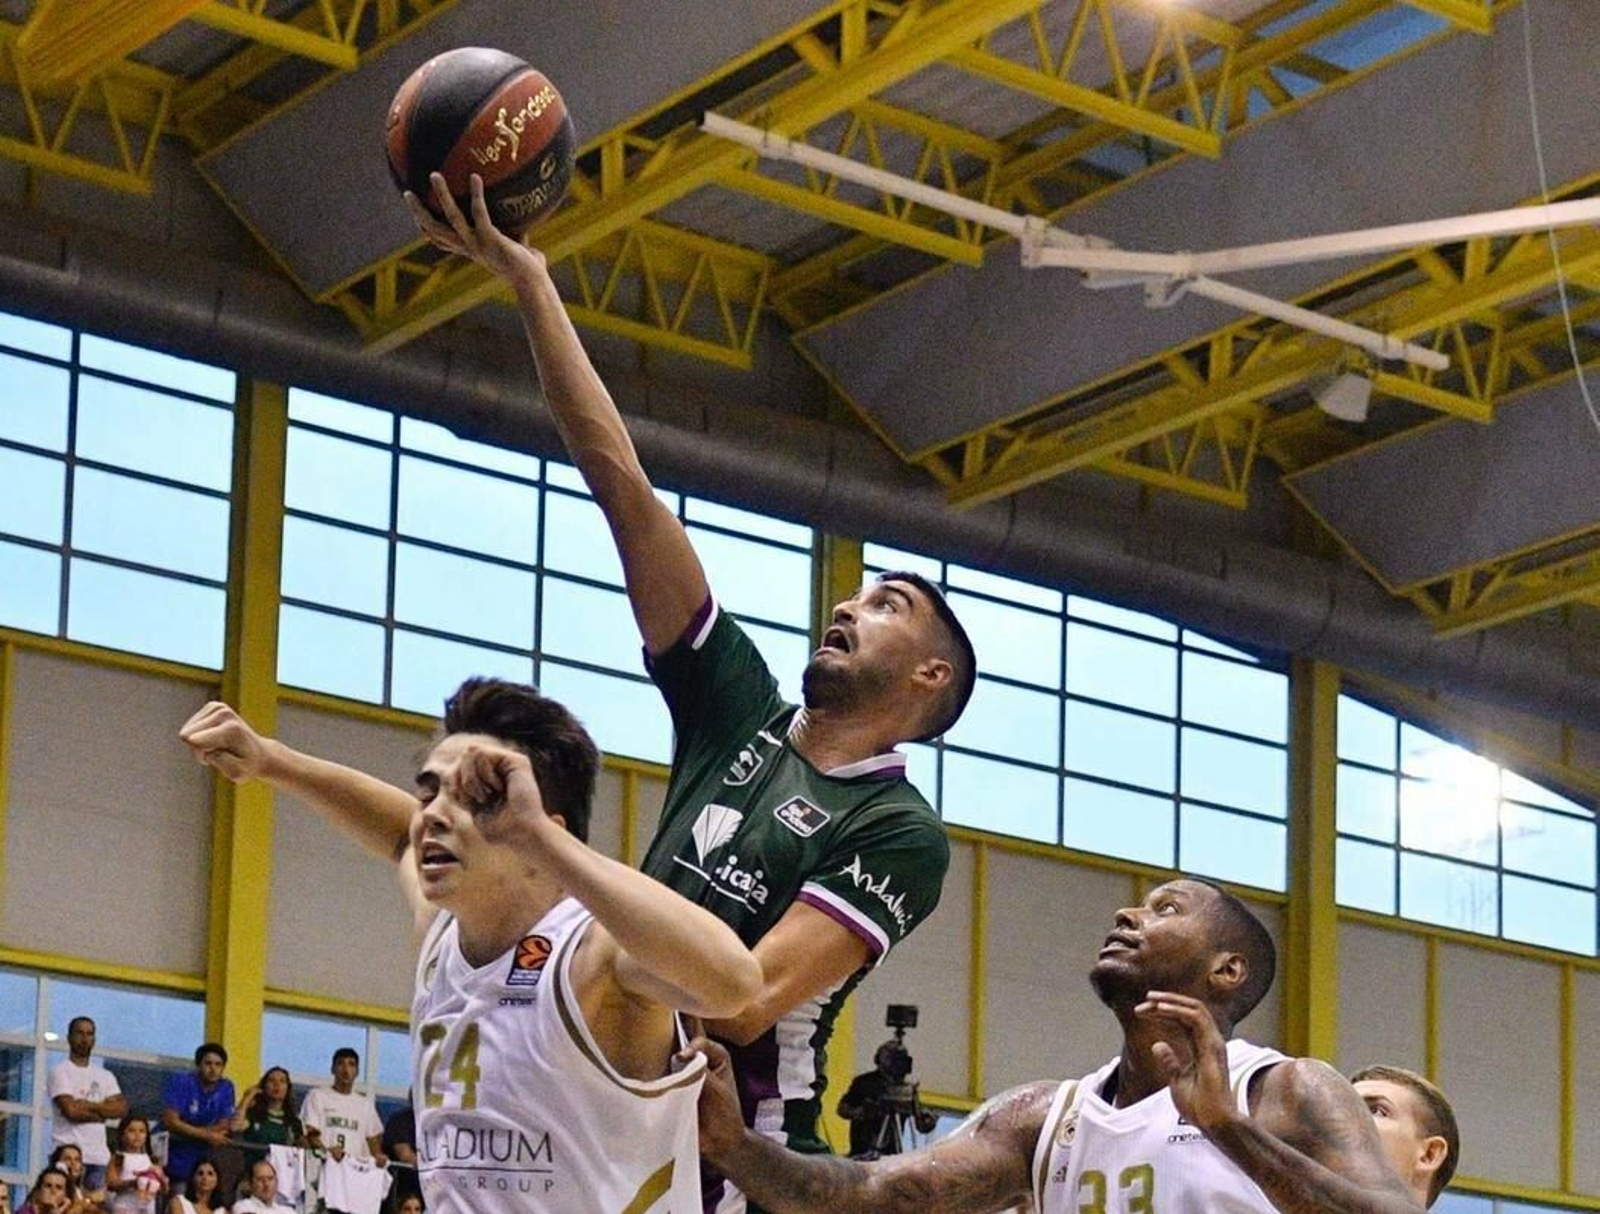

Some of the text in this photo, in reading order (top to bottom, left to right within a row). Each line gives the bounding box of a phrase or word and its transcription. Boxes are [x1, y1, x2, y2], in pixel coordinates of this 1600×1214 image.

[420, 1021, 480, 1109] 24
[1167, 1132, 1207, 1143] onetea
[457, 1175, 554, 1193] GROUP
